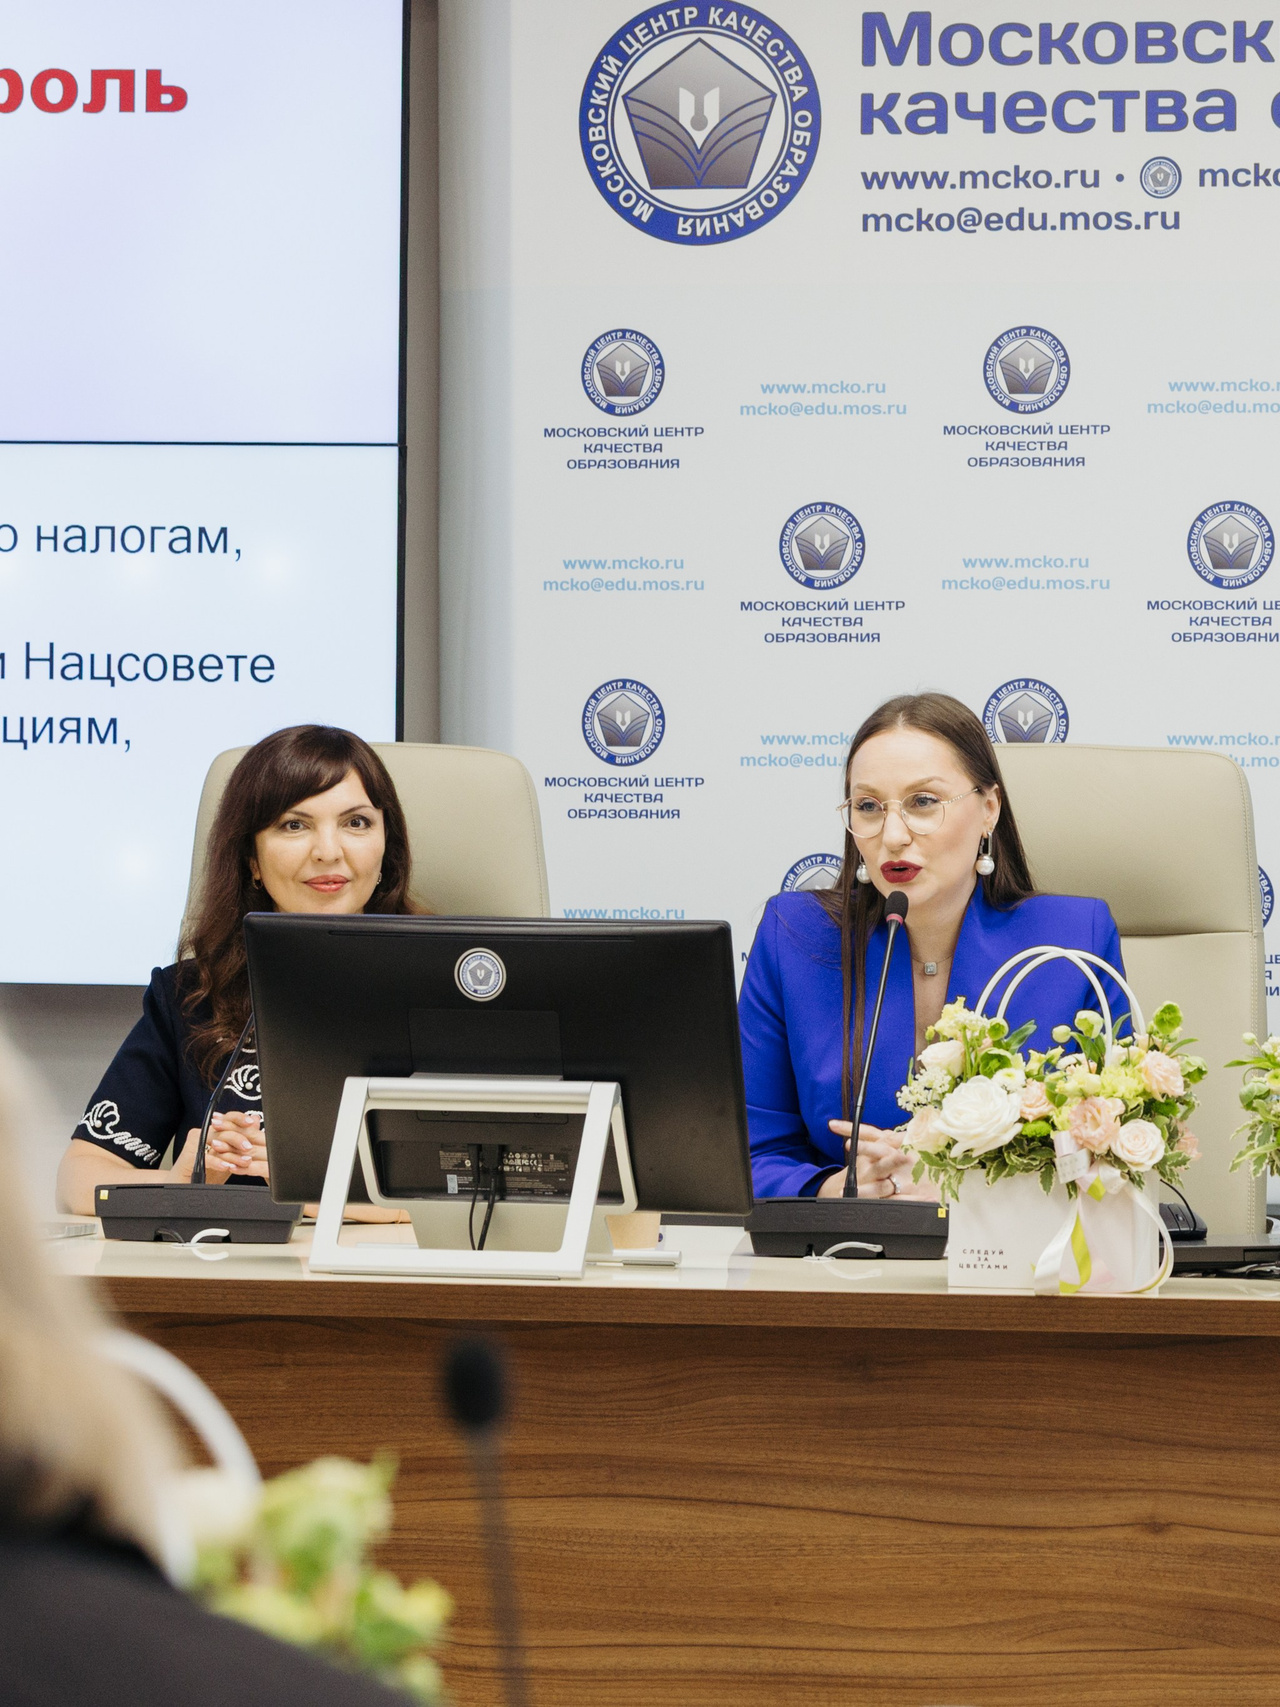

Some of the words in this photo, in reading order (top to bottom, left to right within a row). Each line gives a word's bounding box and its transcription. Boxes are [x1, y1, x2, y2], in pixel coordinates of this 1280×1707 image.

[618, 6, 699, 56] ЦЕНТР
[707, 6, 809, 103] КАЧЕСТВА
[859, 88, 1238, 136] качества
[587, 55, 655, 223] МОСКОВСКИЙ
[676, 109, 814, 237] ОБРАЗОВАНИЯ
[860, 164, 1100, 191] www.mcko.ru
[861, 206, 1181, 235] mcko@edu.mos.ru
[595, 331, 622, 348] ЦЕНТР
[998, 328, 1026, 345] ЦЕНТР
[1030, 328, 1067, 362] КАЧЕСТВА
[626, 331, 661, 365] КАЧЕСТВА
[584, 350, 606, 409] МОСКОВСКИЙ
[986, 347, 1010, 407] МОСКОВСКИЙ
[615, 369, 662, 414] ОБРАЗОВАНИЯ
[761, 381, 885, 394] www.mcko.ru
[1019, 366, 1068, 412] ОБРАЗОВАНИЯ
[740, 402, 906, 416] mcko@edu.mos.ru
[544, 424, 649, 438] МОСКОВСКИЙ
[654, 427, 704, 437] ЦЕНТР
[943, 422, 1053, 435] МОСКОВСКИЙ
[1059, 424, 1110, 435] ЦЕНТР
[584, 443, 663, 453] КАЧЕСТВА
[985, 441, 1068, 451] КАЧЕСТВА
[567, 459, 680, 469] ОБРАЗОВАНИЯ
[967, 457, 1085, 467] ОБРАЗОВАНИЯ
[794, 504, 822, 521] ЦЕНТР
[1202, 503, 1230, 520] ЦЕНТР
[1234, 503, 1271, 537] КАЧЕСТВА
[826, 504, 862, 538] КАЧЕСТВА
[36, 525, 242, 563] налогам,
[1190, 522, 1214, 582] МОСКОВСКИЙ
[782, 523, 805, 583] МОСКОВСКИЙ
[963, 555, 1089, 568] www.mcko.ru
[563, 557, 684, 569] www.mcko.ru
[814, 542, 863, 588] ОБРАЗОВАНИЯ
[1223, 541, 1272, 587] ОБРАЗОВАНИЯ
[544, 578, 704, 592] mcko@edu.mos.ru
[942, 577, 1110, 591] mcko@edu.mos.ru
[740, 598, 849, 611] МОСКОВСКИЙ
[854, 601, 905, 611] ЦЕНТР
[1147, 597, 1257, 610] МОСКОВСКИЙ
[782, 617, 863, 627] КАЧЕСТВА
[1189, 616, 1272, 626] КАЧЕСТВА
[764, 633, 880, 643] ОБРАЗОВАНИЯ
[24, 641, 276, 688] Нацсовете
[595, 681, 623, 698] ЦЕНТР
[627, 681, 662, 715] КАЧЕСТВА
[584, 700, 607, 759] МОСКОВСКИЙ
[616, 719, 663, 764] ОБРАЗОВАНИЯ
[760, 731, 855, 746] www.mck
[740, 752, 848, 768] mcko@edu.
[545, 774, 649, 787] МОСКОВСКИЙ
[654, 777, 704, 787] ЦЕНТР
[584, 793, 663, 803] КАЧЕСТВА
[566, 809, 680, 819] ОБРАЗОВАНИЯ
[563, 906, 685, 919] www.mcko.ru
[962, 1248, 1004, 1256] СЛЕДУЙ
